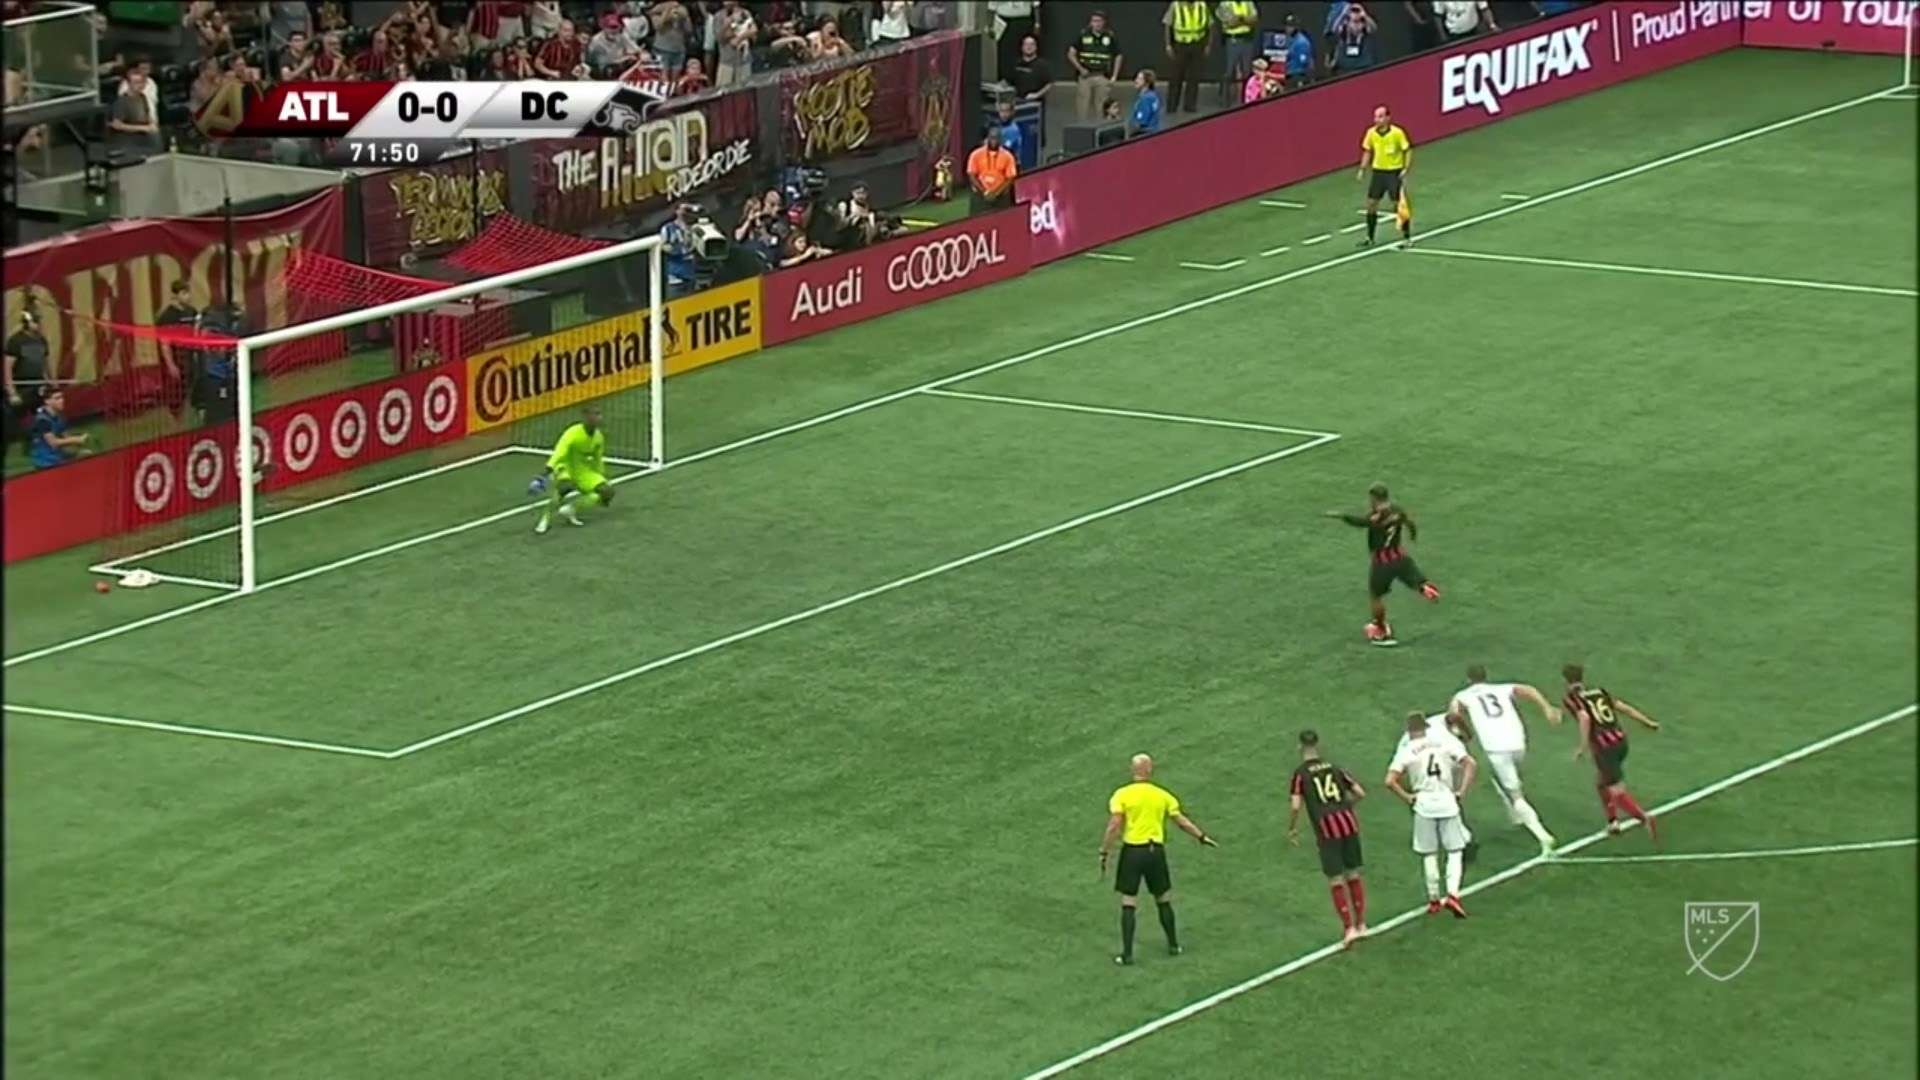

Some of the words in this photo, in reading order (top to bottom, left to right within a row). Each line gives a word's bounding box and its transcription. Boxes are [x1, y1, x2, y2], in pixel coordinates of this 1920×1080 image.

[1631, 3, 1686, 48] Proud
[1442, 20, 1593, 114] EQUIFAX
[552, 148, 598, 194] THE
[790, 265, 863, 322] Audi
[474, 314, 653, 423] Continental
[685, 299, 753, 351] TIRE
[1477, 692, 1504, 719] 13
[1586, 697, 1615, 724] 16
[1312, 773, 1341, 803] 14
[1426, 753, 1442, 781] 4
